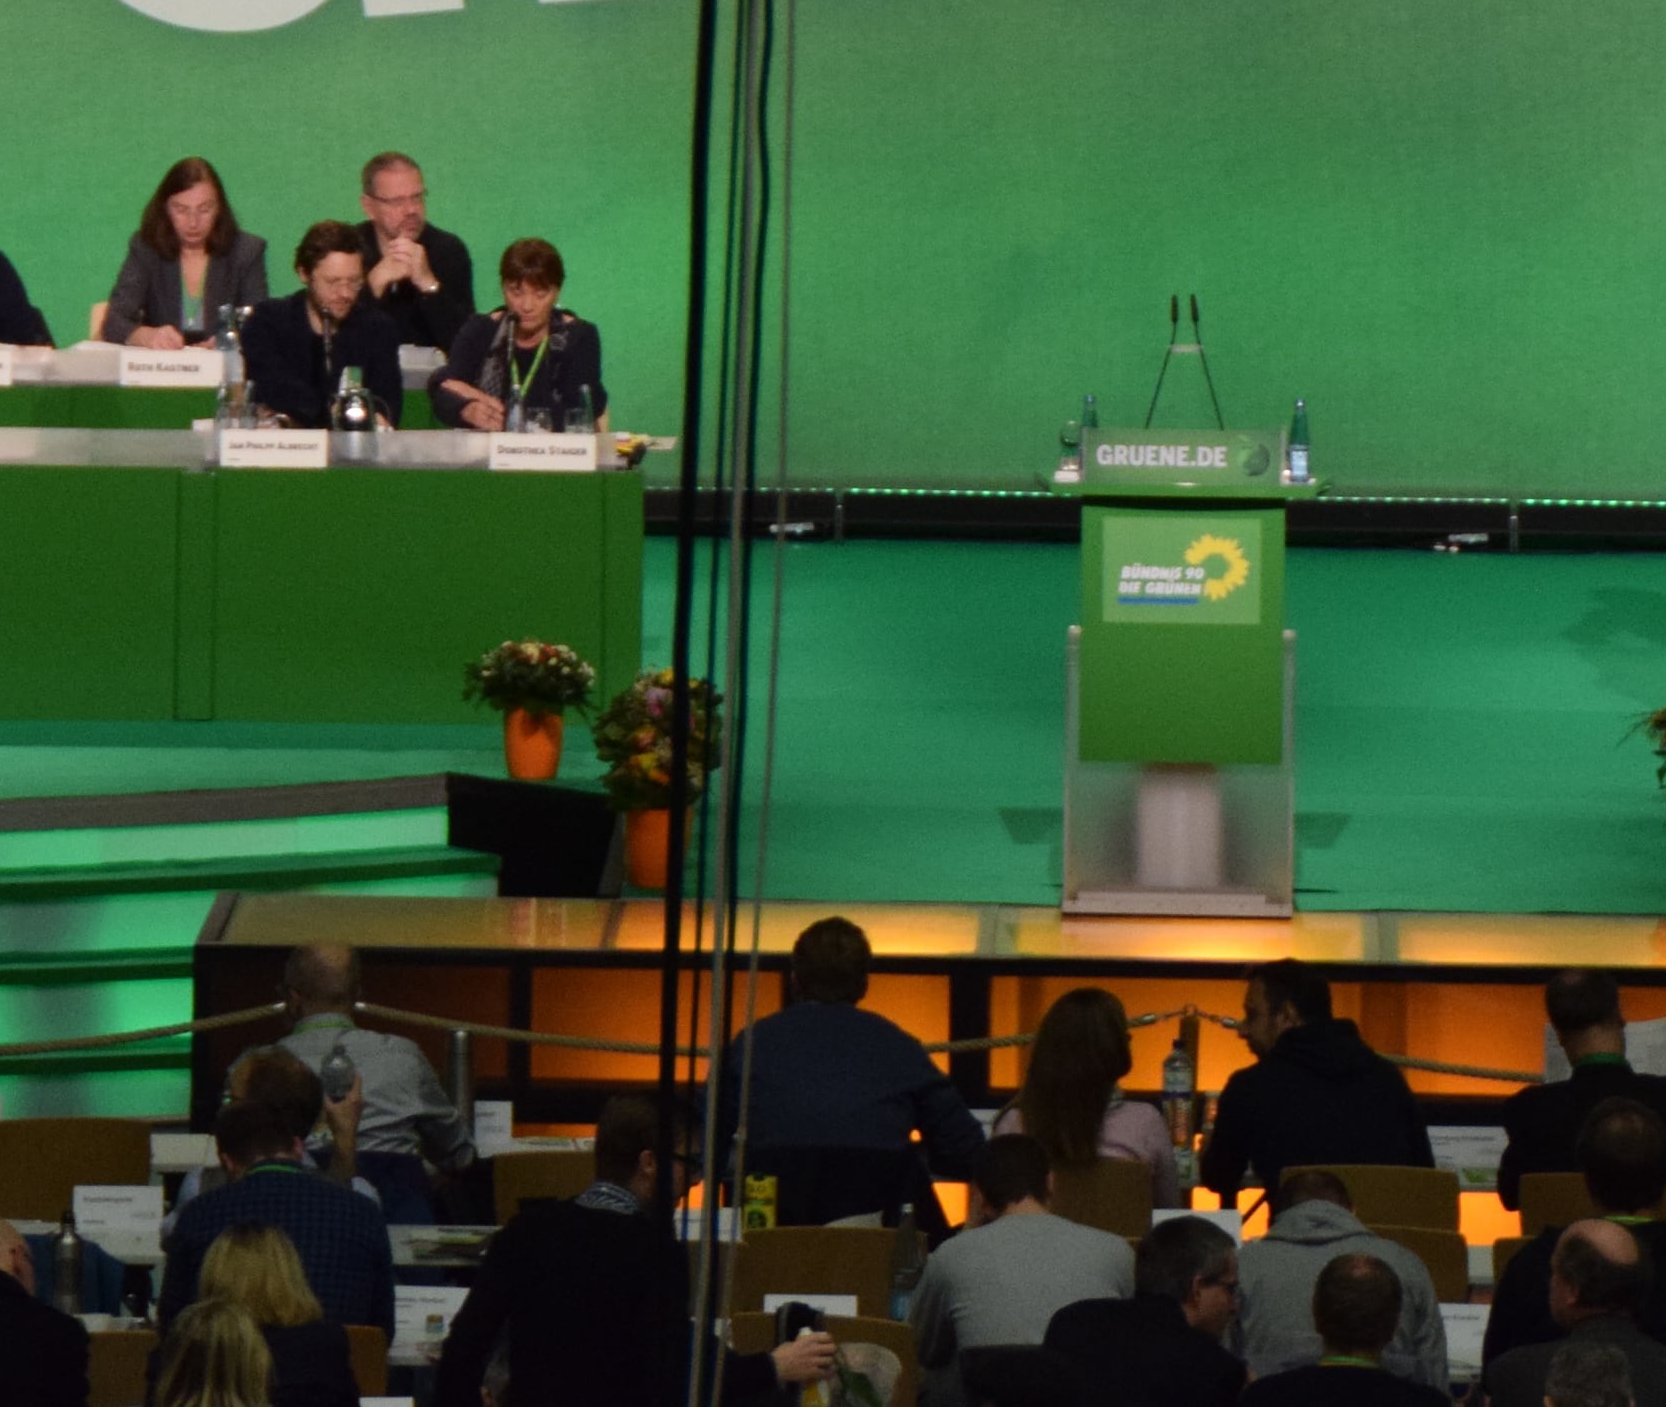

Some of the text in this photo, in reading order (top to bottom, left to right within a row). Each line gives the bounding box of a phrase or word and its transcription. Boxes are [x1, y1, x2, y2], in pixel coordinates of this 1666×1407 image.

[1096, 443, 1229, 469] GRUENE.DE
[1185, 566, 1205, 580] 90
[1118, 579, 1201, 595] DIE GRÜNEN
